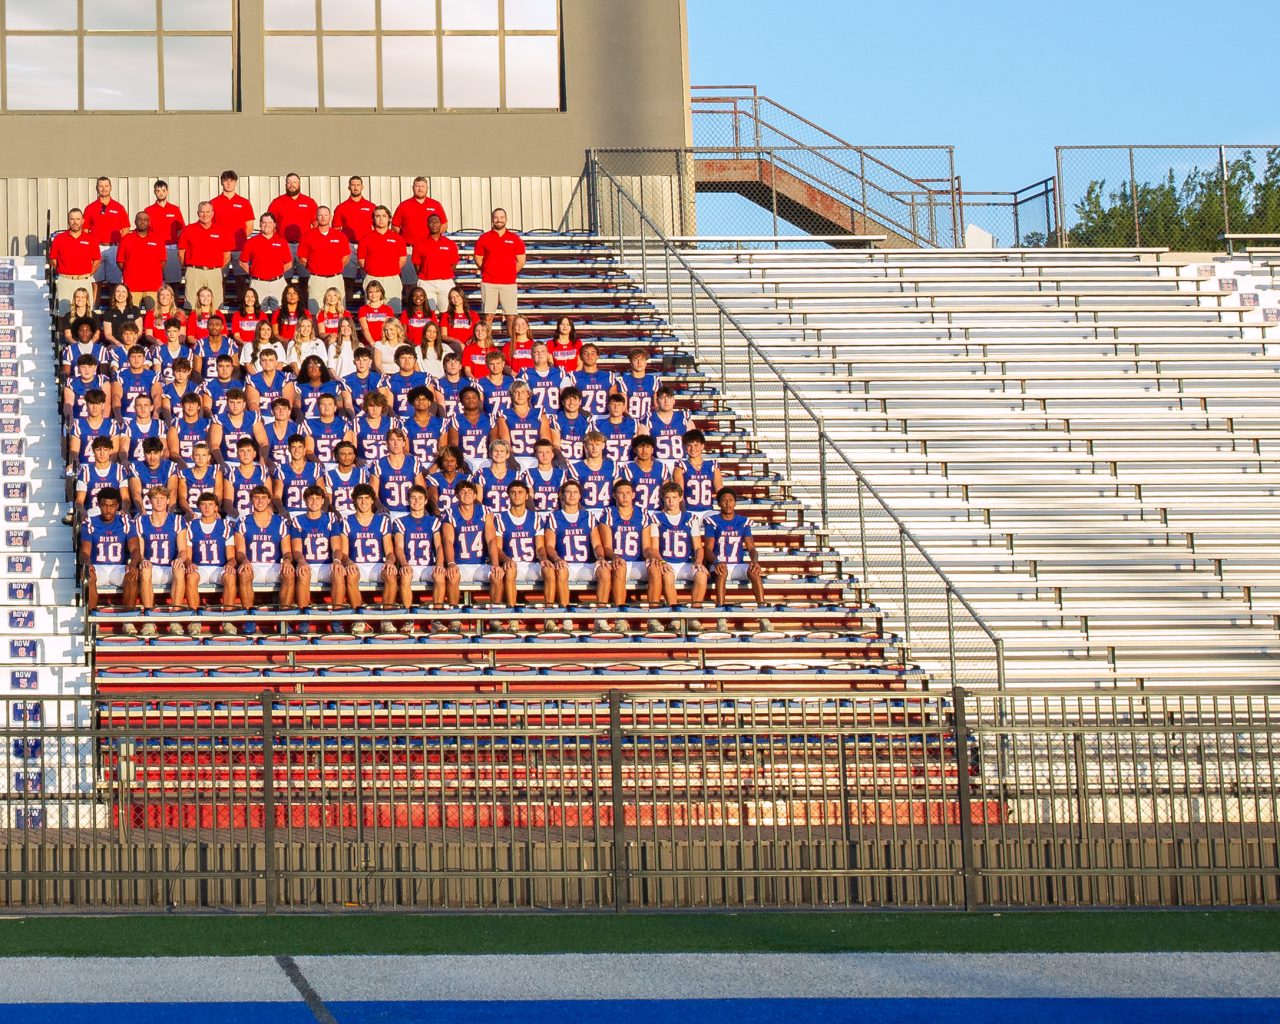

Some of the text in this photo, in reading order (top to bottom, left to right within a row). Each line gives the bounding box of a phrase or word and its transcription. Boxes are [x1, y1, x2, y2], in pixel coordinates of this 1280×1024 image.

[533, 388, 559, 409] 78
[582, 390, 606, 412] 79
[629, 397, 651, 418] 80
[413, 439, 437, 462] 53
[462, 436, 487, 459] 54
[510, 430, 538, 453] 55
[607, 440, 631, 462] 57
[656, 436, 683, 459] 58
[385, 482, 412, 506] 30
[487, 491, 510, 512] 33
[535, 493, 558, 510] 33
[584, 482, 609, 506] 34
[635, 485, 660, 509] 34
[687, 480, 712, 505] 36
[96, 543, 121, 562] 10
[151, 541, 169, 563] 11
[199, 545, 220, 564] 11
[250, 542, 275, 563] 12
[304, 537, 328, 560] 12
[355, 539, 379, 562] 13
[408, 540, 430, 565] 13
[458, 532, 483, 558] 14
[510, 538, 534, 562] 15
[563, 536, 588, 563] 15
[614, 532, 638, 556] 16
[663, 532, 687, 557] 16
[717, 537, 741, 562] 17
[16, 618, 24, 627] 7
